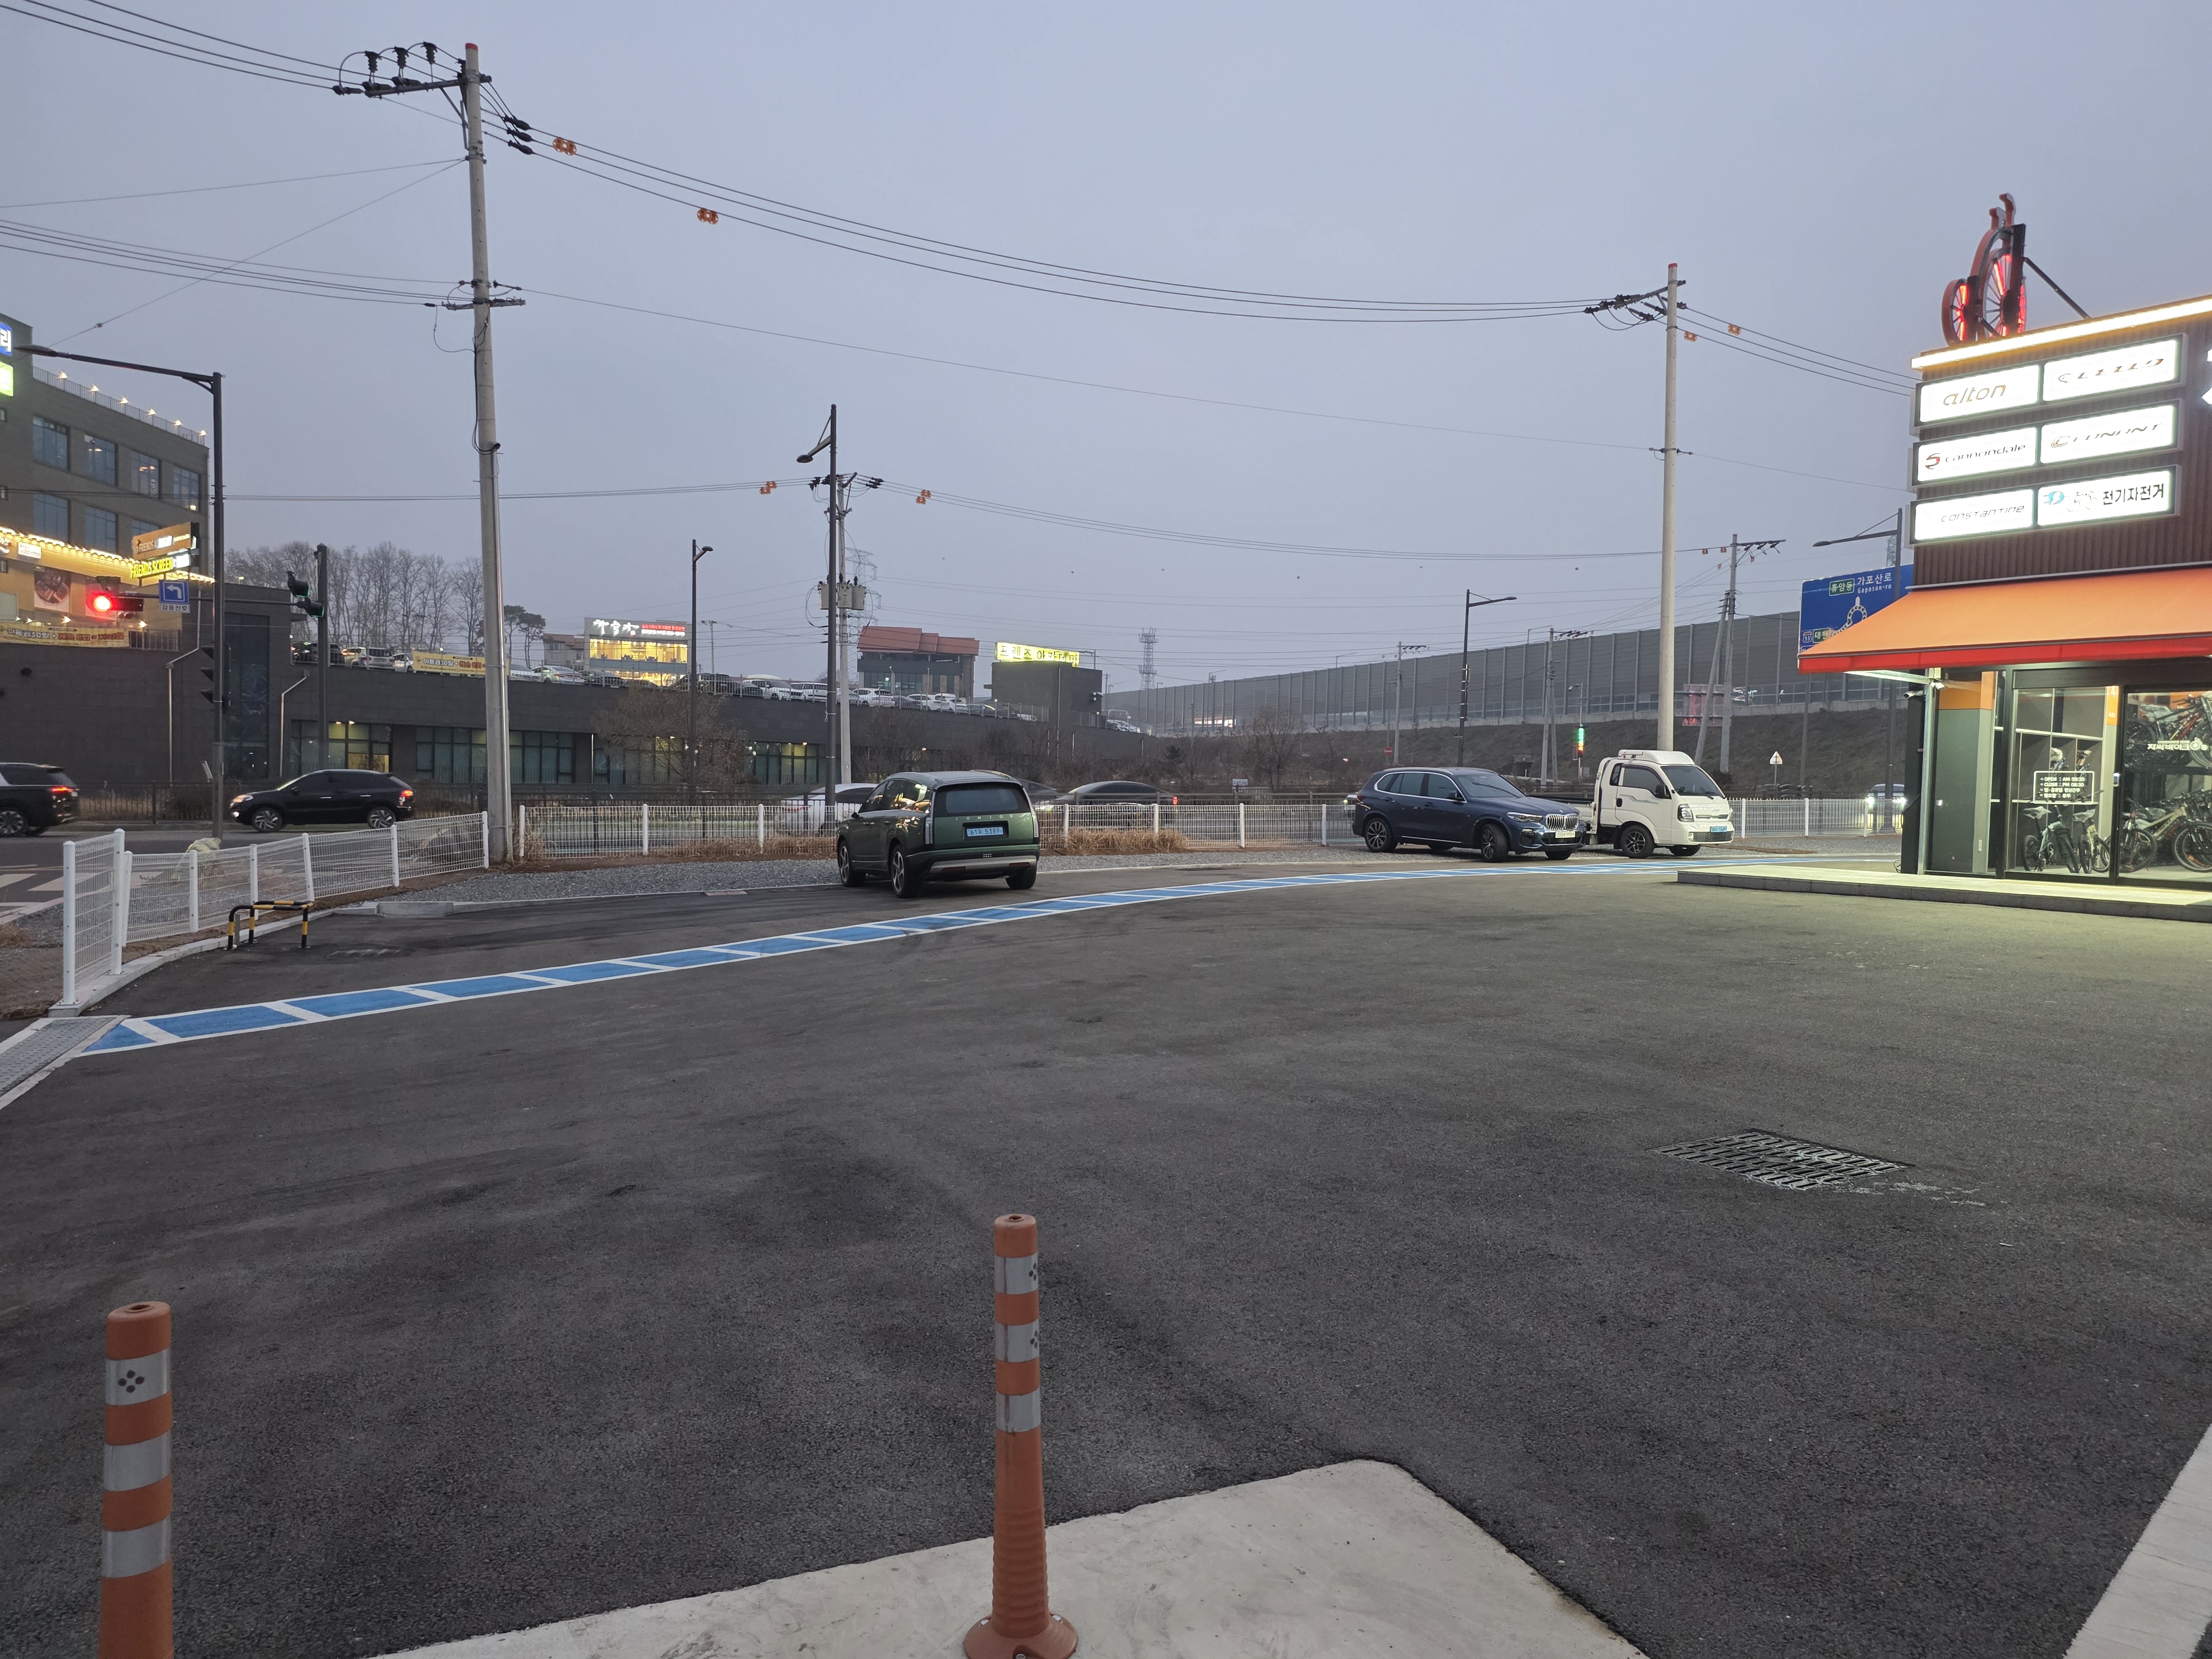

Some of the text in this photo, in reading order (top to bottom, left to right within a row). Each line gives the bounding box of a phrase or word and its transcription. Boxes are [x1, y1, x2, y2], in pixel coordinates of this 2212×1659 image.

[1943, 385, 2006, 405] alton
[1945, 445, 2025, 462] cannondale
[2103, 483, 2163, 505] 전기자전거
[130, 561, 152, 578] FRIENDS
[152, 557, 173, 573] SCREEN
[1831, 573, 1892, 593] 휴암동 가포산로
[1858, 584, 1892, 593] Gaposan-ro
[1814, 631, 1828, 640] 대전
[1000, 645, 1077, 666] 프렌즈 아카데미
